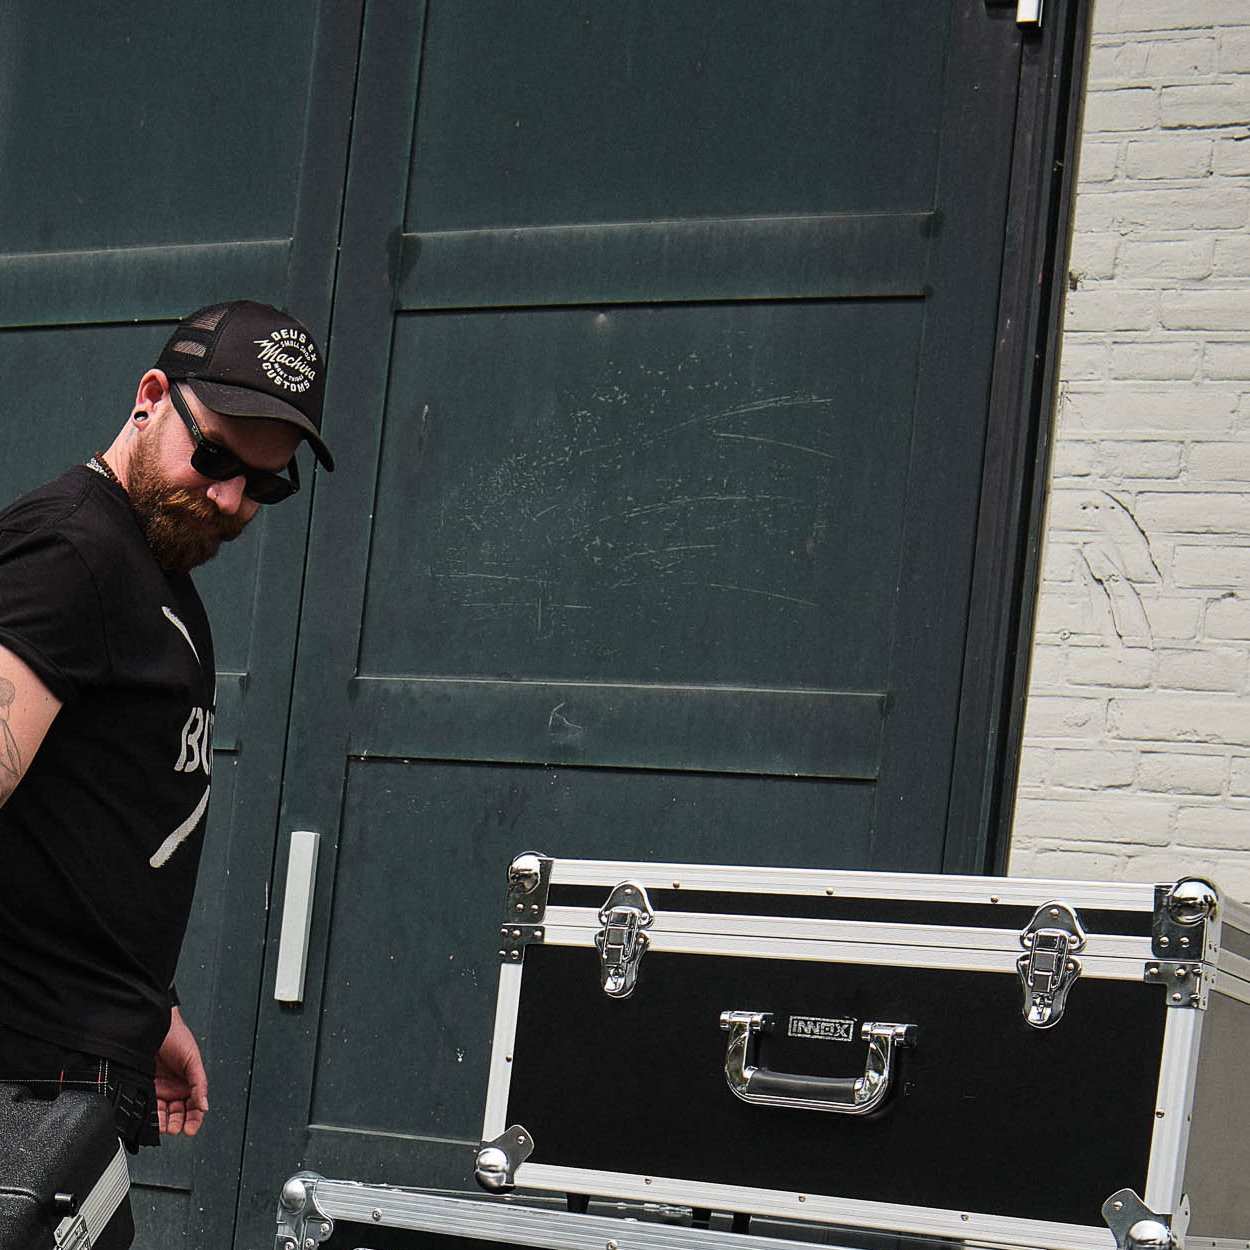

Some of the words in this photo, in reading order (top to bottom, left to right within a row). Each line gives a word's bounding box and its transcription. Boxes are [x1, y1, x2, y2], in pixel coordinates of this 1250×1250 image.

[254, 340, 316, 380] Machina
[271, 329, 306, 343] DEUS
[308, 344, 316, 362] EX
[280, 340, 300, 349] SMALL
[262, 362, 310, 393] CUSTOMS
[792, 1020, 849, 1038] INNOX
